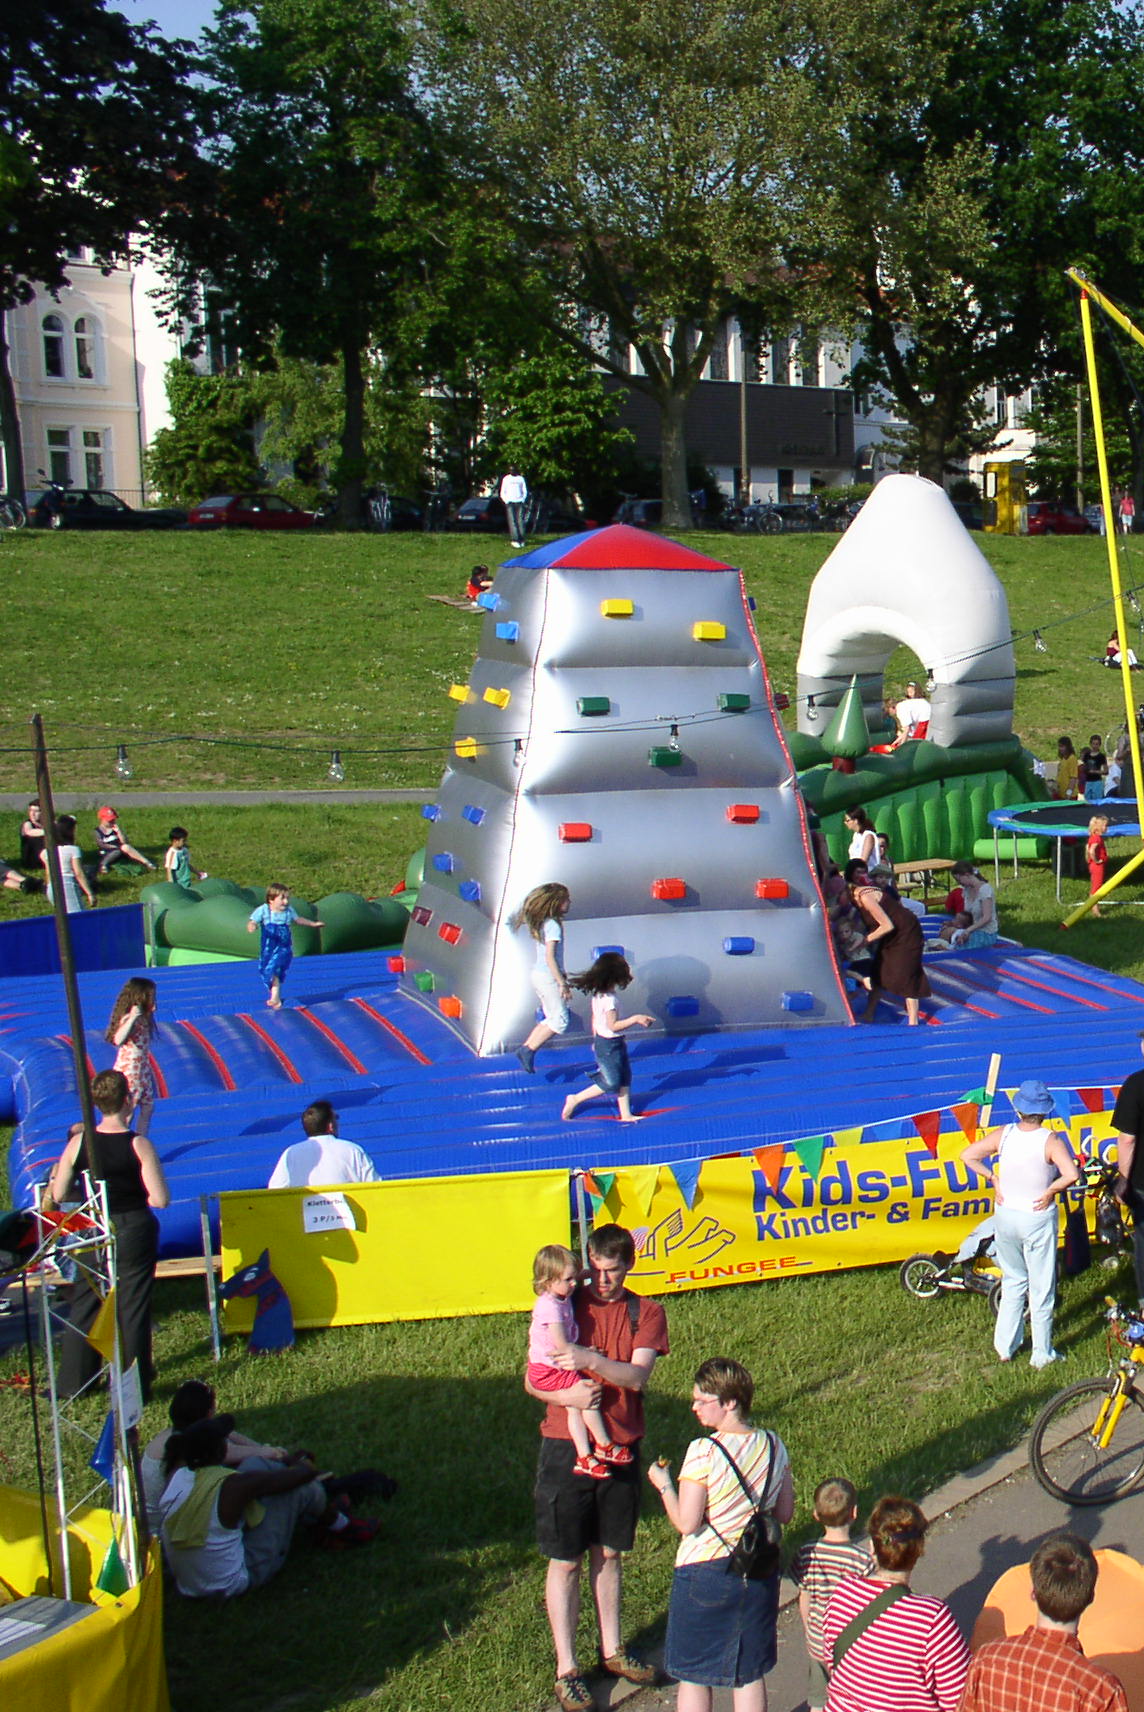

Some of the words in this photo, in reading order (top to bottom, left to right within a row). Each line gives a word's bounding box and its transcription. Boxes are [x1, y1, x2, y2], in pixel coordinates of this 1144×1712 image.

[755, 1207, 876, 1241] Kinder-
[886, 1201, 910, 1225] &
[921, 1196, 995, 1220] Fam
[669, 1256, 797, 1283] FUNGEE
